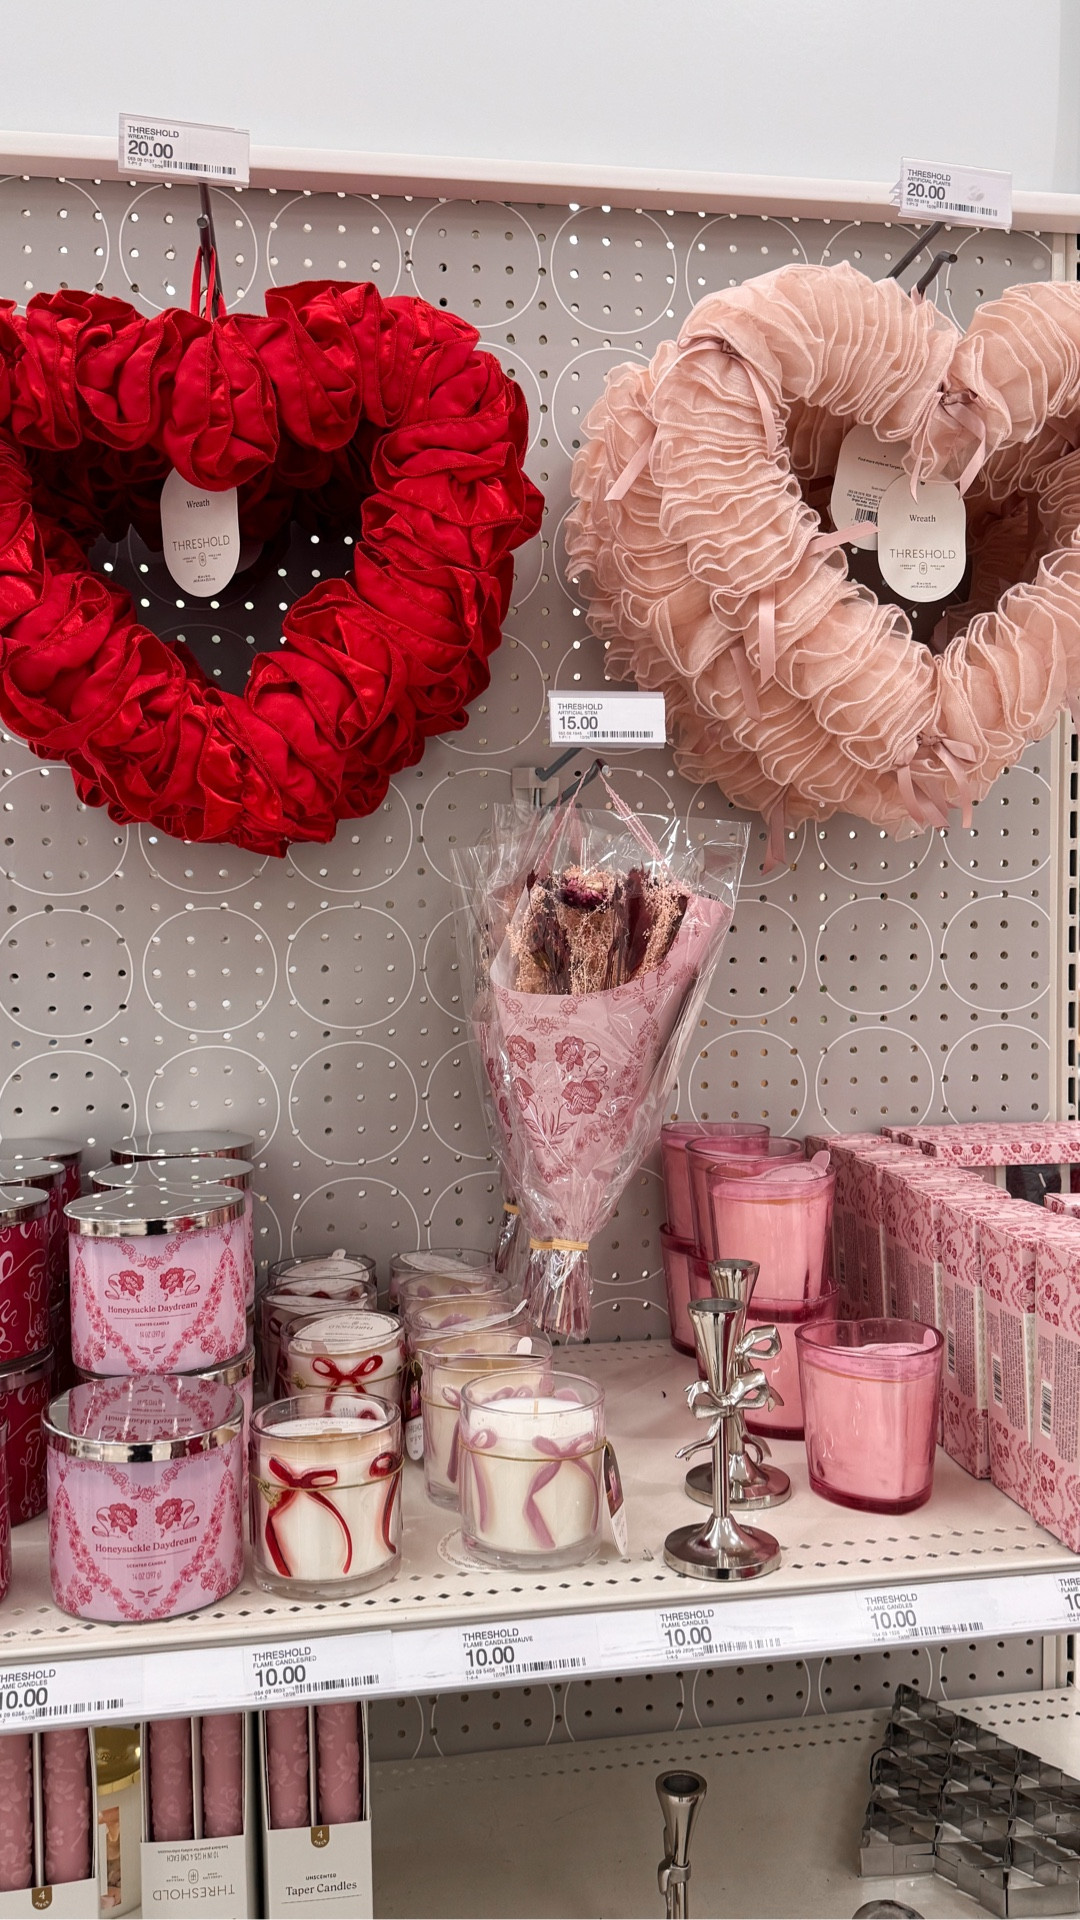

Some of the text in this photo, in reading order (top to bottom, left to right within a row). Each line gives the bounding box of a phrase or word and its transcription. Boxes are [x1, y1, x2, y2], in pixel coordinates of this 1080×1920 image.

[128, 126, 179, 138] THRESHOLD
[128, 140, 173, 159] 20.00
[907, 176, 932, 184] ARTIFICIAL
[908, 169, 951, 181] THRESHOLD
[907, 182, 945, 200] 20.00
[186, 499, 210, 508] Wreath
[909, 514, 936, 522] Wreath
[173, 535, 230, 551] THRESHOLD
[890, 549, 956, 559] THRESHOLD
[559, 716, 598, 730] 15.00
[108, 1300, 198, 1316] Honeysuckle Daydream
[96, 1535, 197, 1554] Honeysuckle Daydream
[864, 1593, 918, 1605] THRESHOLD
[660, 1609, 714, 1621] THRESHOLD
[870, 1610, 916, 1630] 10.00
[661, 1619, 709, 1629] FLAME CANDLES
[463, 1628, 519, 1641] THRESHOLD
[664, 1626, 712, 1647] 10.00
[463, 1636, 533, 1649] FLAME CANDLESMAUVE
[253, 1646, 312, 1662] THRESHOLD
[466, 1645, 515, 1667] 10.00
[253, 1655, 317, 1669] FLAME CANDLESRED
[0, 1669, 56, 1683] HRESHOLD
[255, 1665, 306, 1688] 10.00
[17, 1679, 48, 1688] CANDLES
[0, 1687, 48, 1710] 10.00
[317, 1830, 323, 1839] 4
[167, 1854, 179, 1862] EACH
[39, 1890, 45, 1900] 4
[153, 1884, 235, 1900] THRESHOLD
[286, 1881, 357, 1896] Taper Candles
